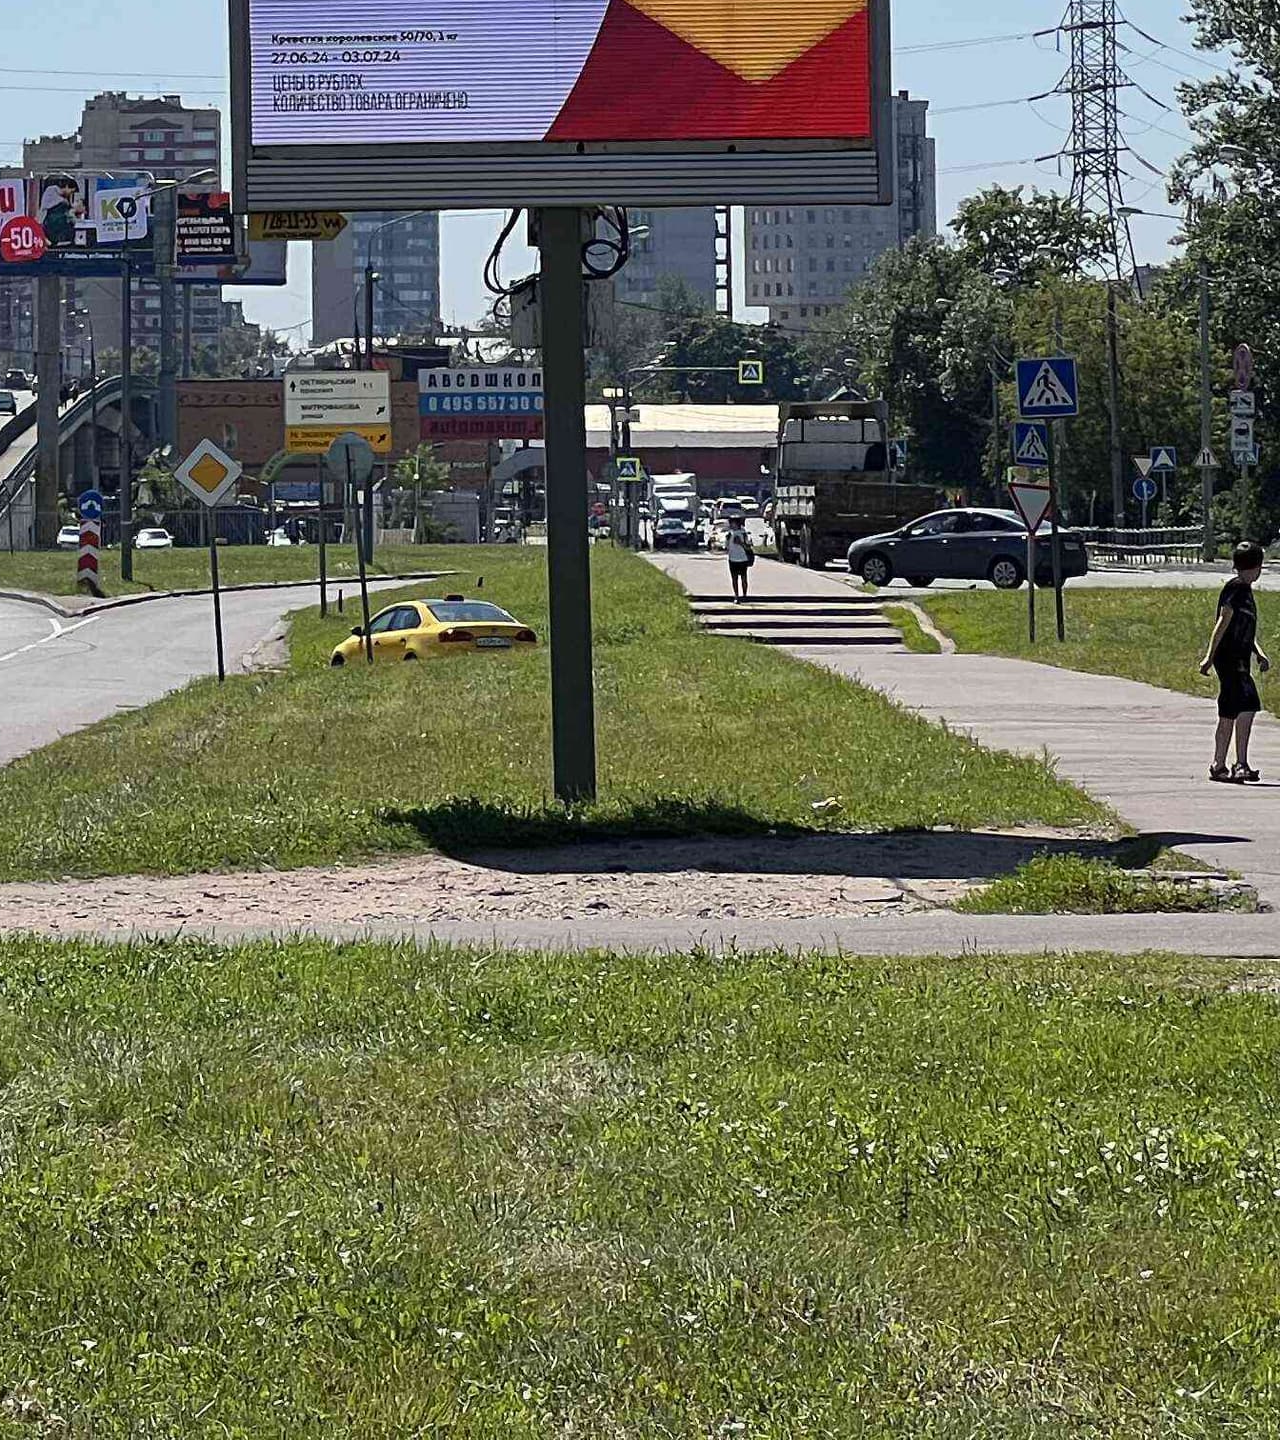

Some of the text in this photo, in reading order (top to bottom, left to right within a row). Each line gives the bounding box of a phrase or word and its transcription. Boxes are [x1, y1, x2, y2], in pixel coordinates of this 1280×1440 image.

[326, 33, 397, 45] королевские
[271, 52, 329, 64] 27.06.24
[341, 51, 400, 63] 03.07.24
[273, 75, 306, 93] ЦЕНЫ
[273, 93, 346, 111] КОЛИЧЕСТВО
[349, 93, 392, 110] ТОВАРА
